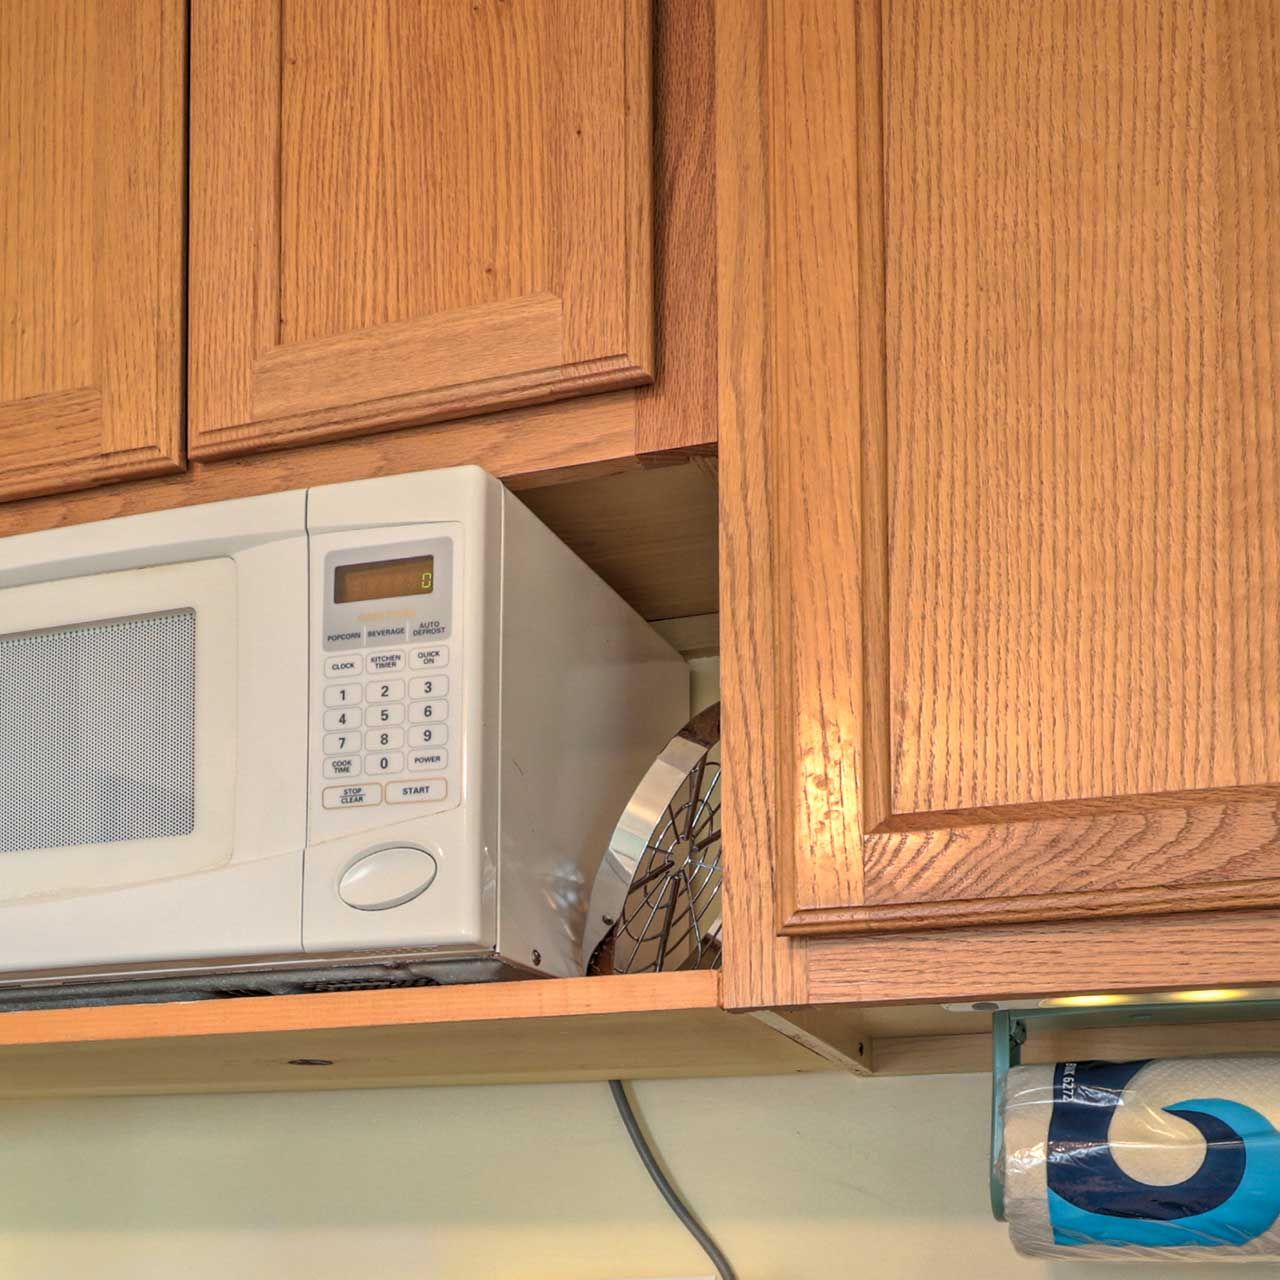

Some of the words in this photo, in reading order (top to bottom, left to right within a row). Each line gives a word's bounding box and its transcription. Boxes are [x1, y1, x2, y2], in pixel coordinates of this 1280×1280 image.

[419, 621, 440, 629] AUTO
[327, 632, 361, 642] POPCORN
[367, 628, 405, 638] BEVERAGE
[413, 627, 446, 637] DEFROST
[371, 655, 401, 663] KITCHEN
[417, 651, 440, 659] QUICK
[331, 662, 355, 670] CLOCK
[381, 686, 390, 697] 2
[424, 681, 433, 693] 3
[339, 690, 346, 701] 1
[380, 710, 389, 721] 5
[424, 706, 433, 717] 6
[338, 713, 346, 725] 4
[380, 733, 389, 745] 8
[423, 730, 432, 742] 9
[338, 737, 346, 749] 7
[332, 760, 352, 768] COOK
[380, 757, 388, 769] 0
[414, 756, 441, 764] POWER
[343, 788, 362, 796] STOP
[403, 786, 430, 796] START
[340, 797, 363, 805] CLEAR
[1062, 1077, 1075, 1102] 6272
